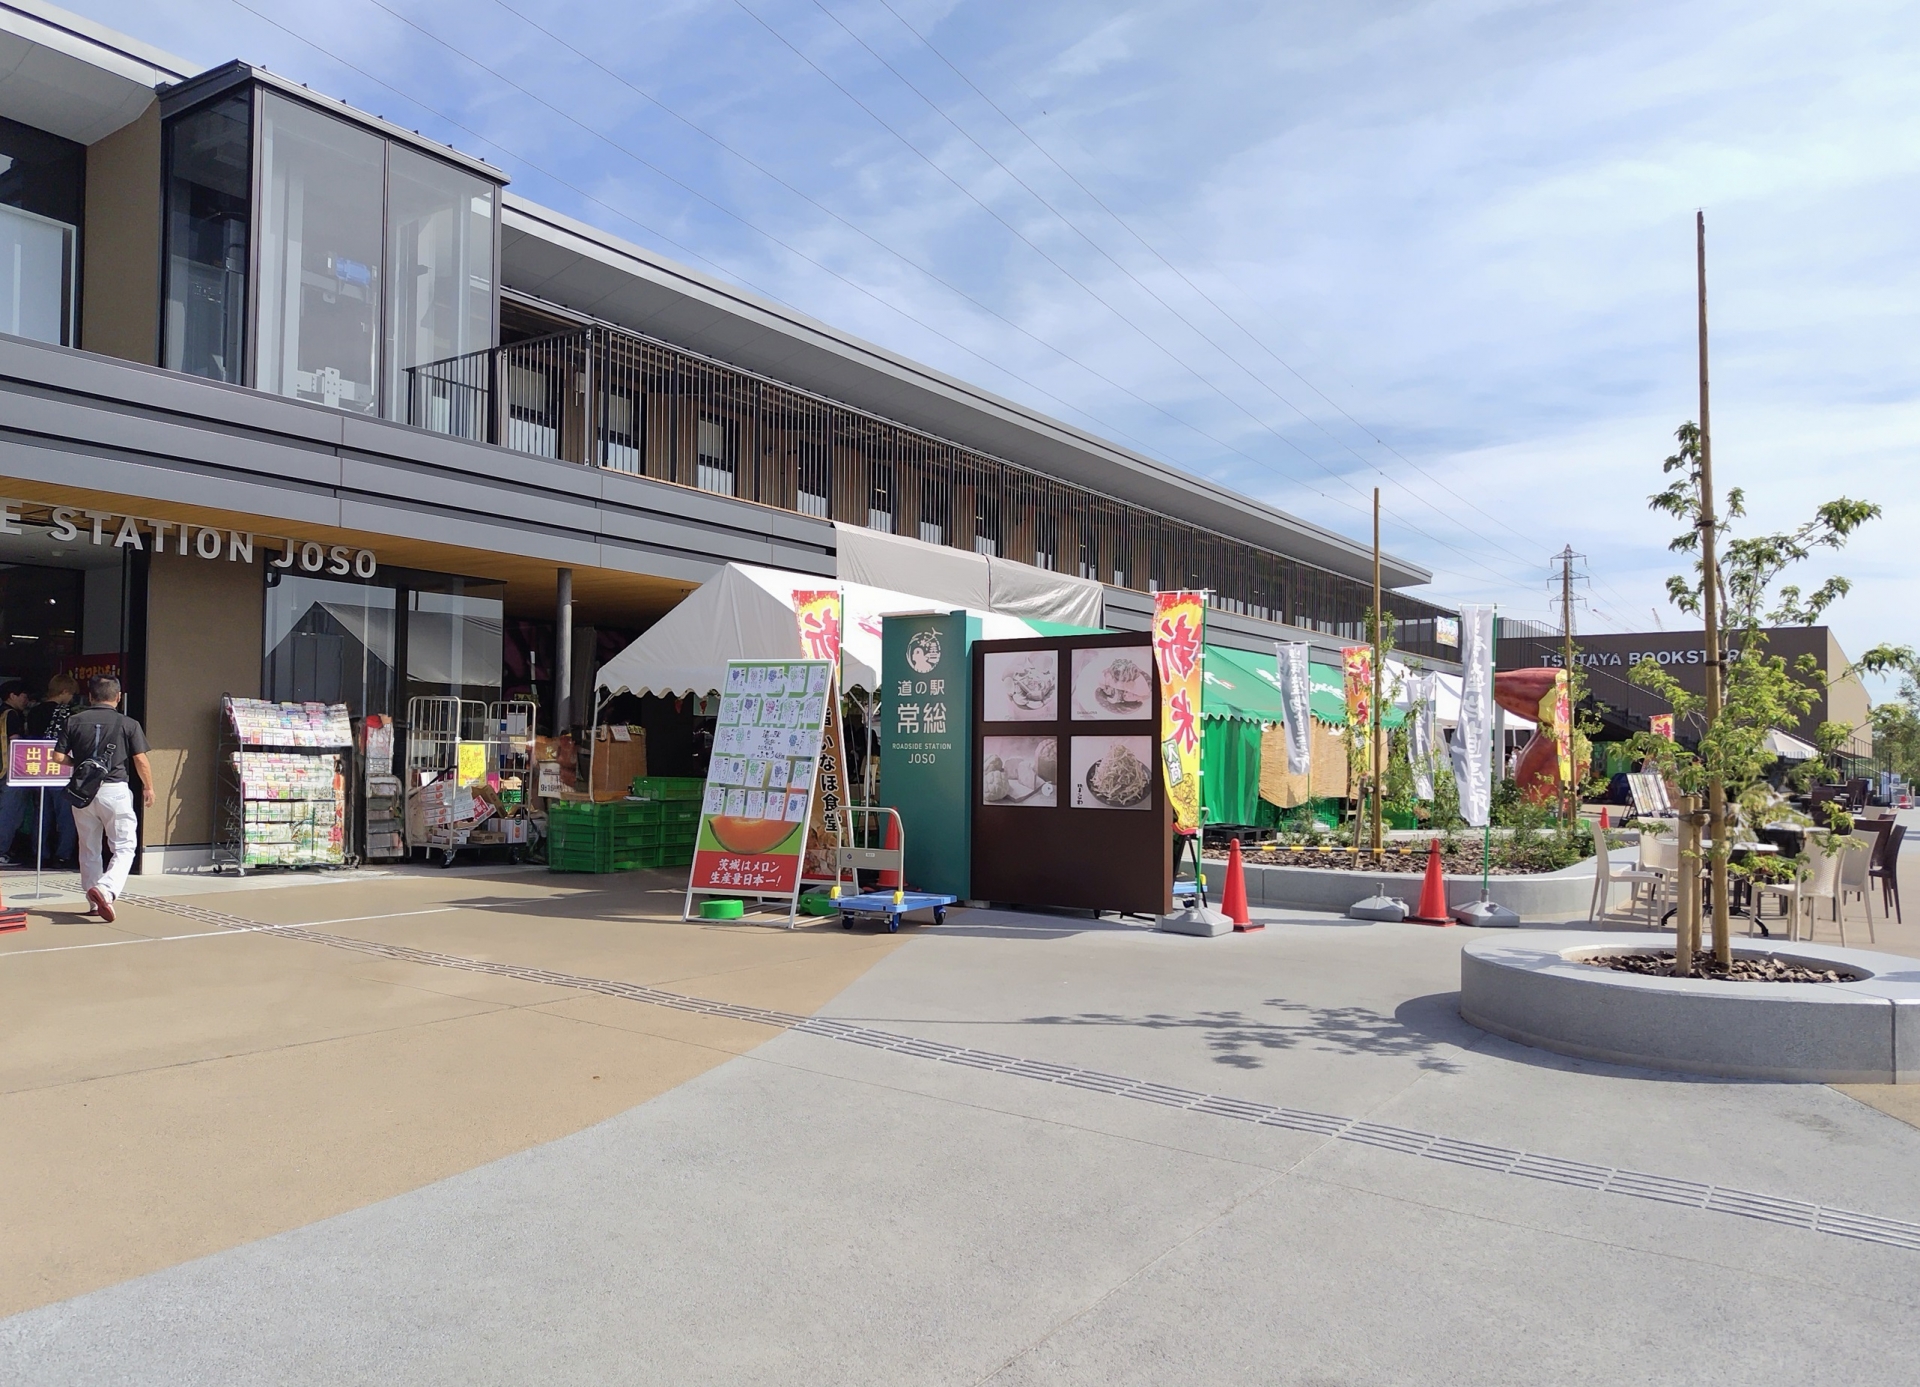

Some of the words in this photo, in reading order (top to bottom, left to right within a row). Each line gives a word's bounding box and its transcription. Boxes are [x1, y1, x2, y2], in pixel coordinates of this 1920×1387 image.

[51, 505, 254, 564] STATION
[272, 538, 377, 579] JOSO
[897, 679, 945, 697] 道の駅
[897, 702, 947, 734] 常総
[892, 742, 923, 750] ROADSIDE
[924, 742, 952, 750] STATION
[908, 753, 936, 764] JOSO
[26, 762, 60, 776] 専用
[820, 735, 841, 832] いなほ食堂
[717, 858, 780, 873] 茨城はメロン
[709, 871, 782, 887] 生産量日本一!
